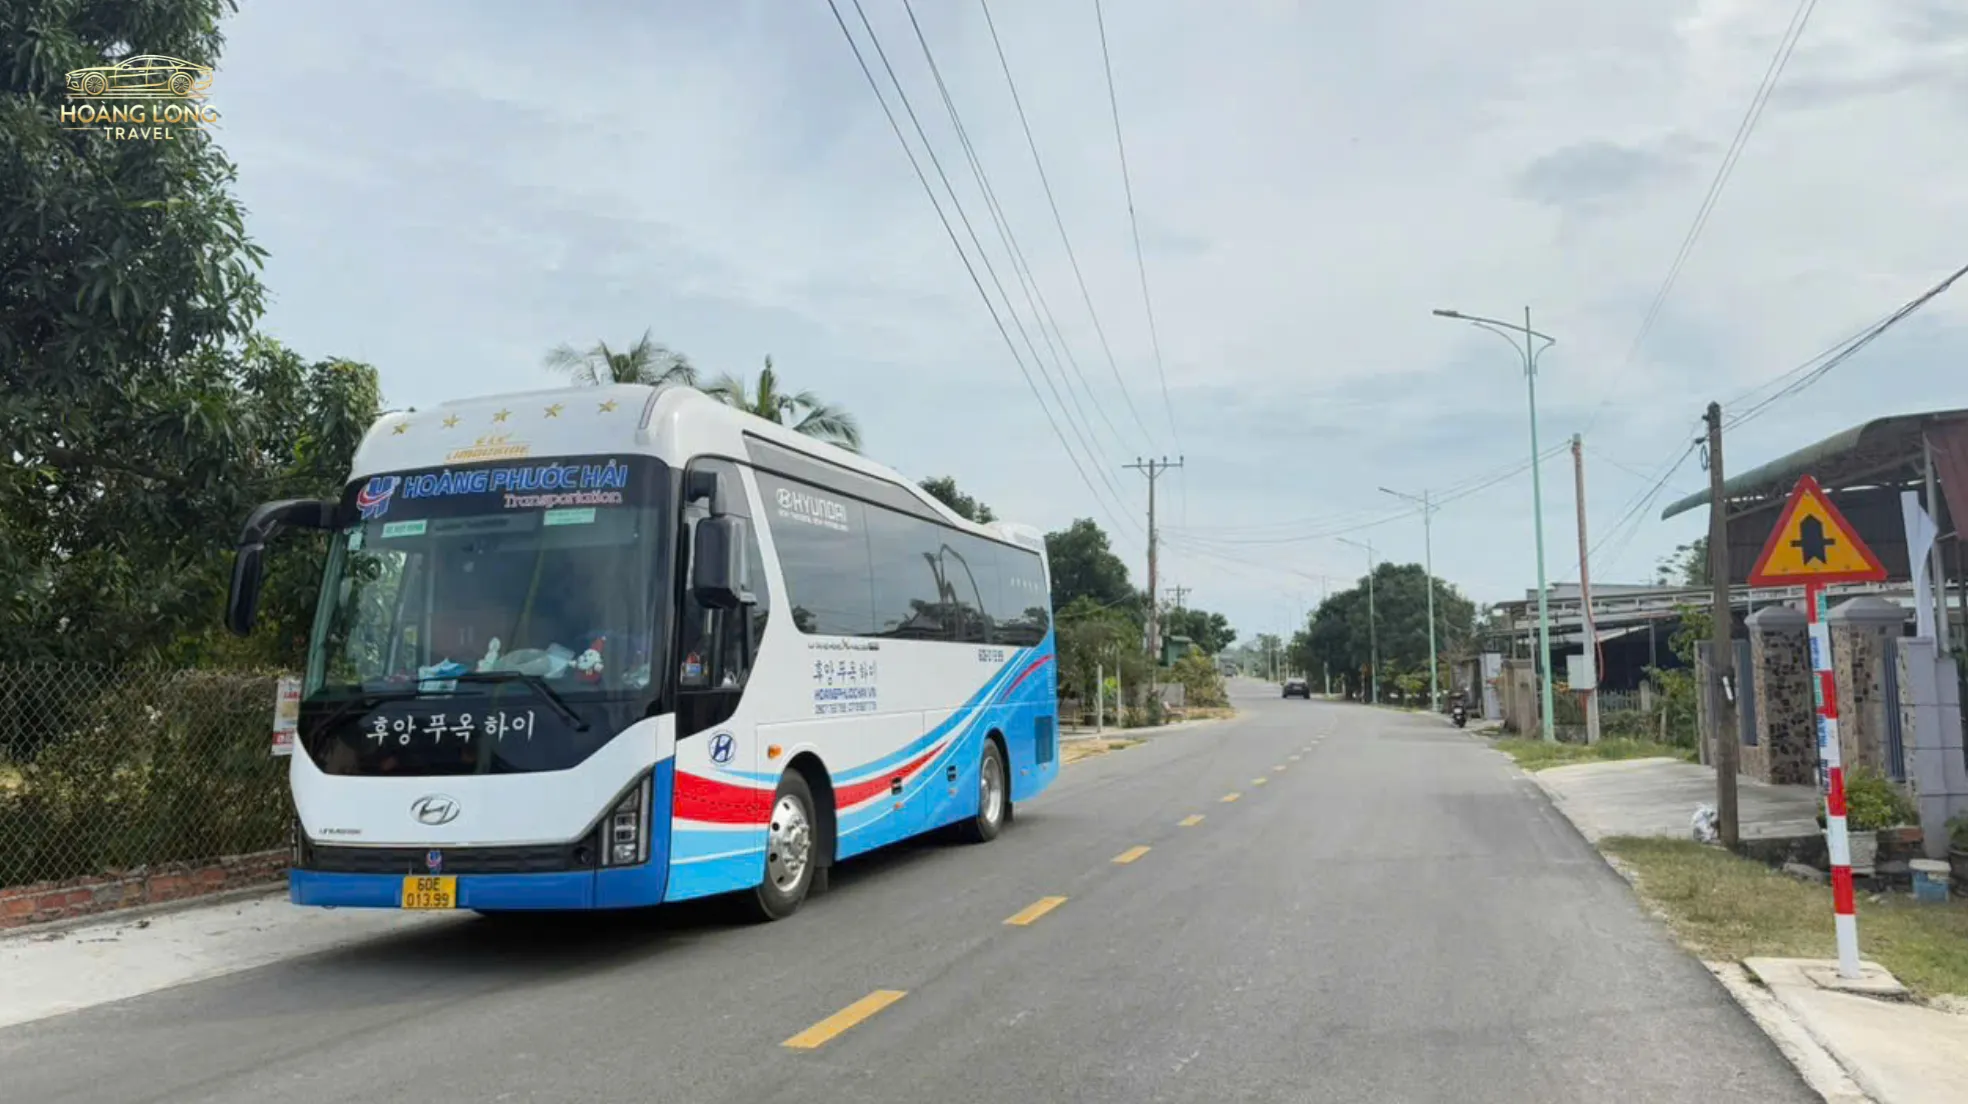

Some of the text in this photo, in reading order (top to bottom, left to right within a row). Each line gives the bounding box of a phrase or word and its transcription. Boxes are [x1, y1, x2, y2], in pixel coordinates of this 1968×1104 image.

[403, 468, 488, 498] HOÀNG
[580, 459, 628, 488] HẢI
[503, 489, 623, 509] Transportation
[366, 710, 536, 746] 후앙 푸옥 하이
[417, 877, 441, 891] 60E
